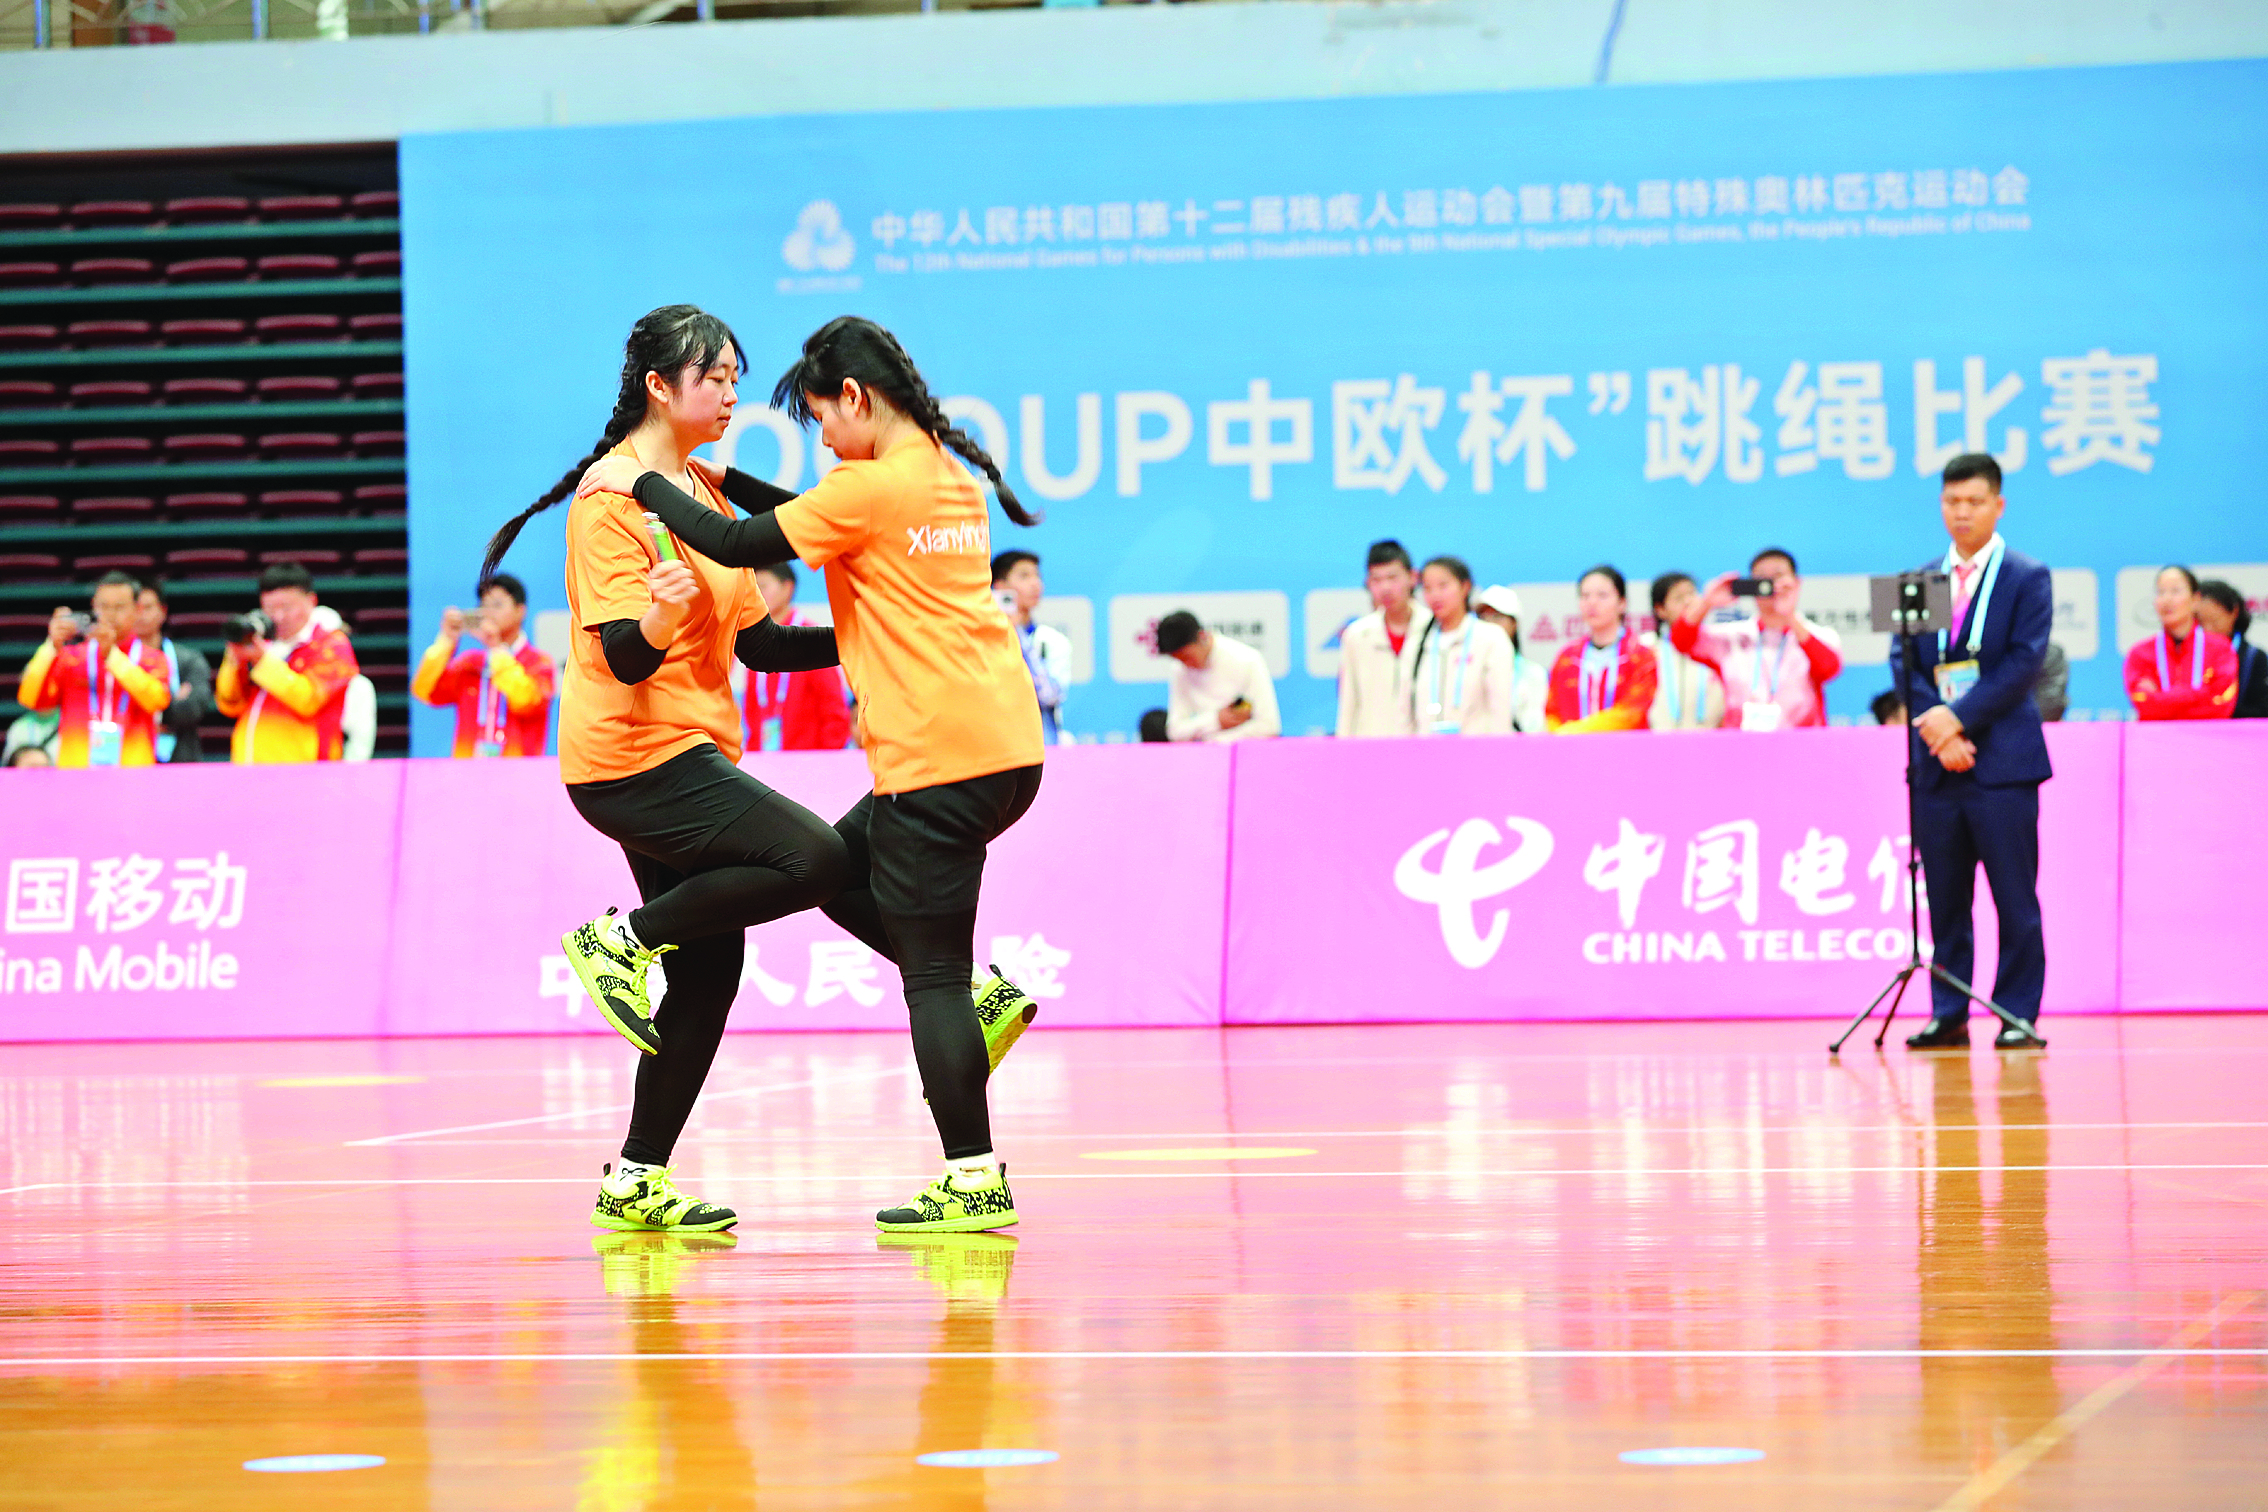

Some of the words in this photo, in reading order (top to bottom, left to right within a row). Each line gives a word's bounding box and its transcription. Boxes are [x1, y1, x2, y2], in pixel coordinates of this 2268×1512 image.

[871, 164, 2030, 250] 中华人民共和国第十二届残疾人运动会暨第九届特殊奥林匹克运动会
[955, 249, 1032, 271] National
[1974, 210, 2032, 233] China
[5, 850, 248, 934] 国移动
[74, 939, 240, 991] Mobile
[1583, 930, 1726, 964] CHINA
